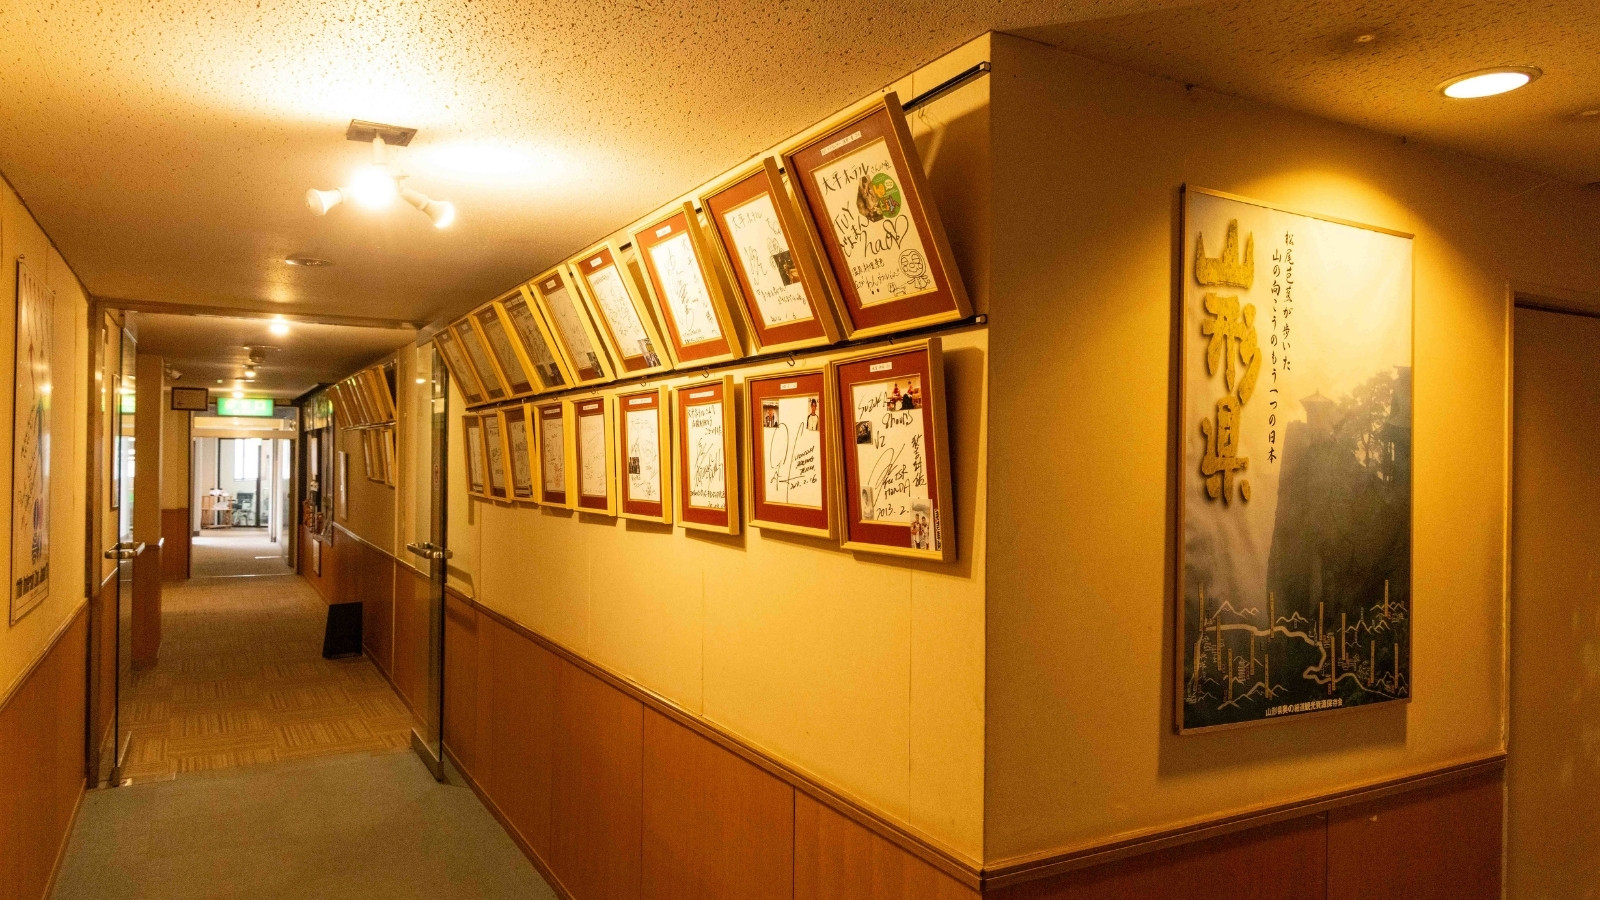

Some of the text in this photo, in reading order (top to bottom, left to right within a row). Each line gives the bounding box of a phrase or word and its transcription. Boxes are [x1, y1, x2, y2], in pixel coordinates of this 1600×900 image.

[1195, 218, 1262, 505] 山形県
[1267, 249, 1282, 464] 山の向こうのもう一つの日本
[1283, 231, 1295, 371] 松尾芭蕉が歩いた
